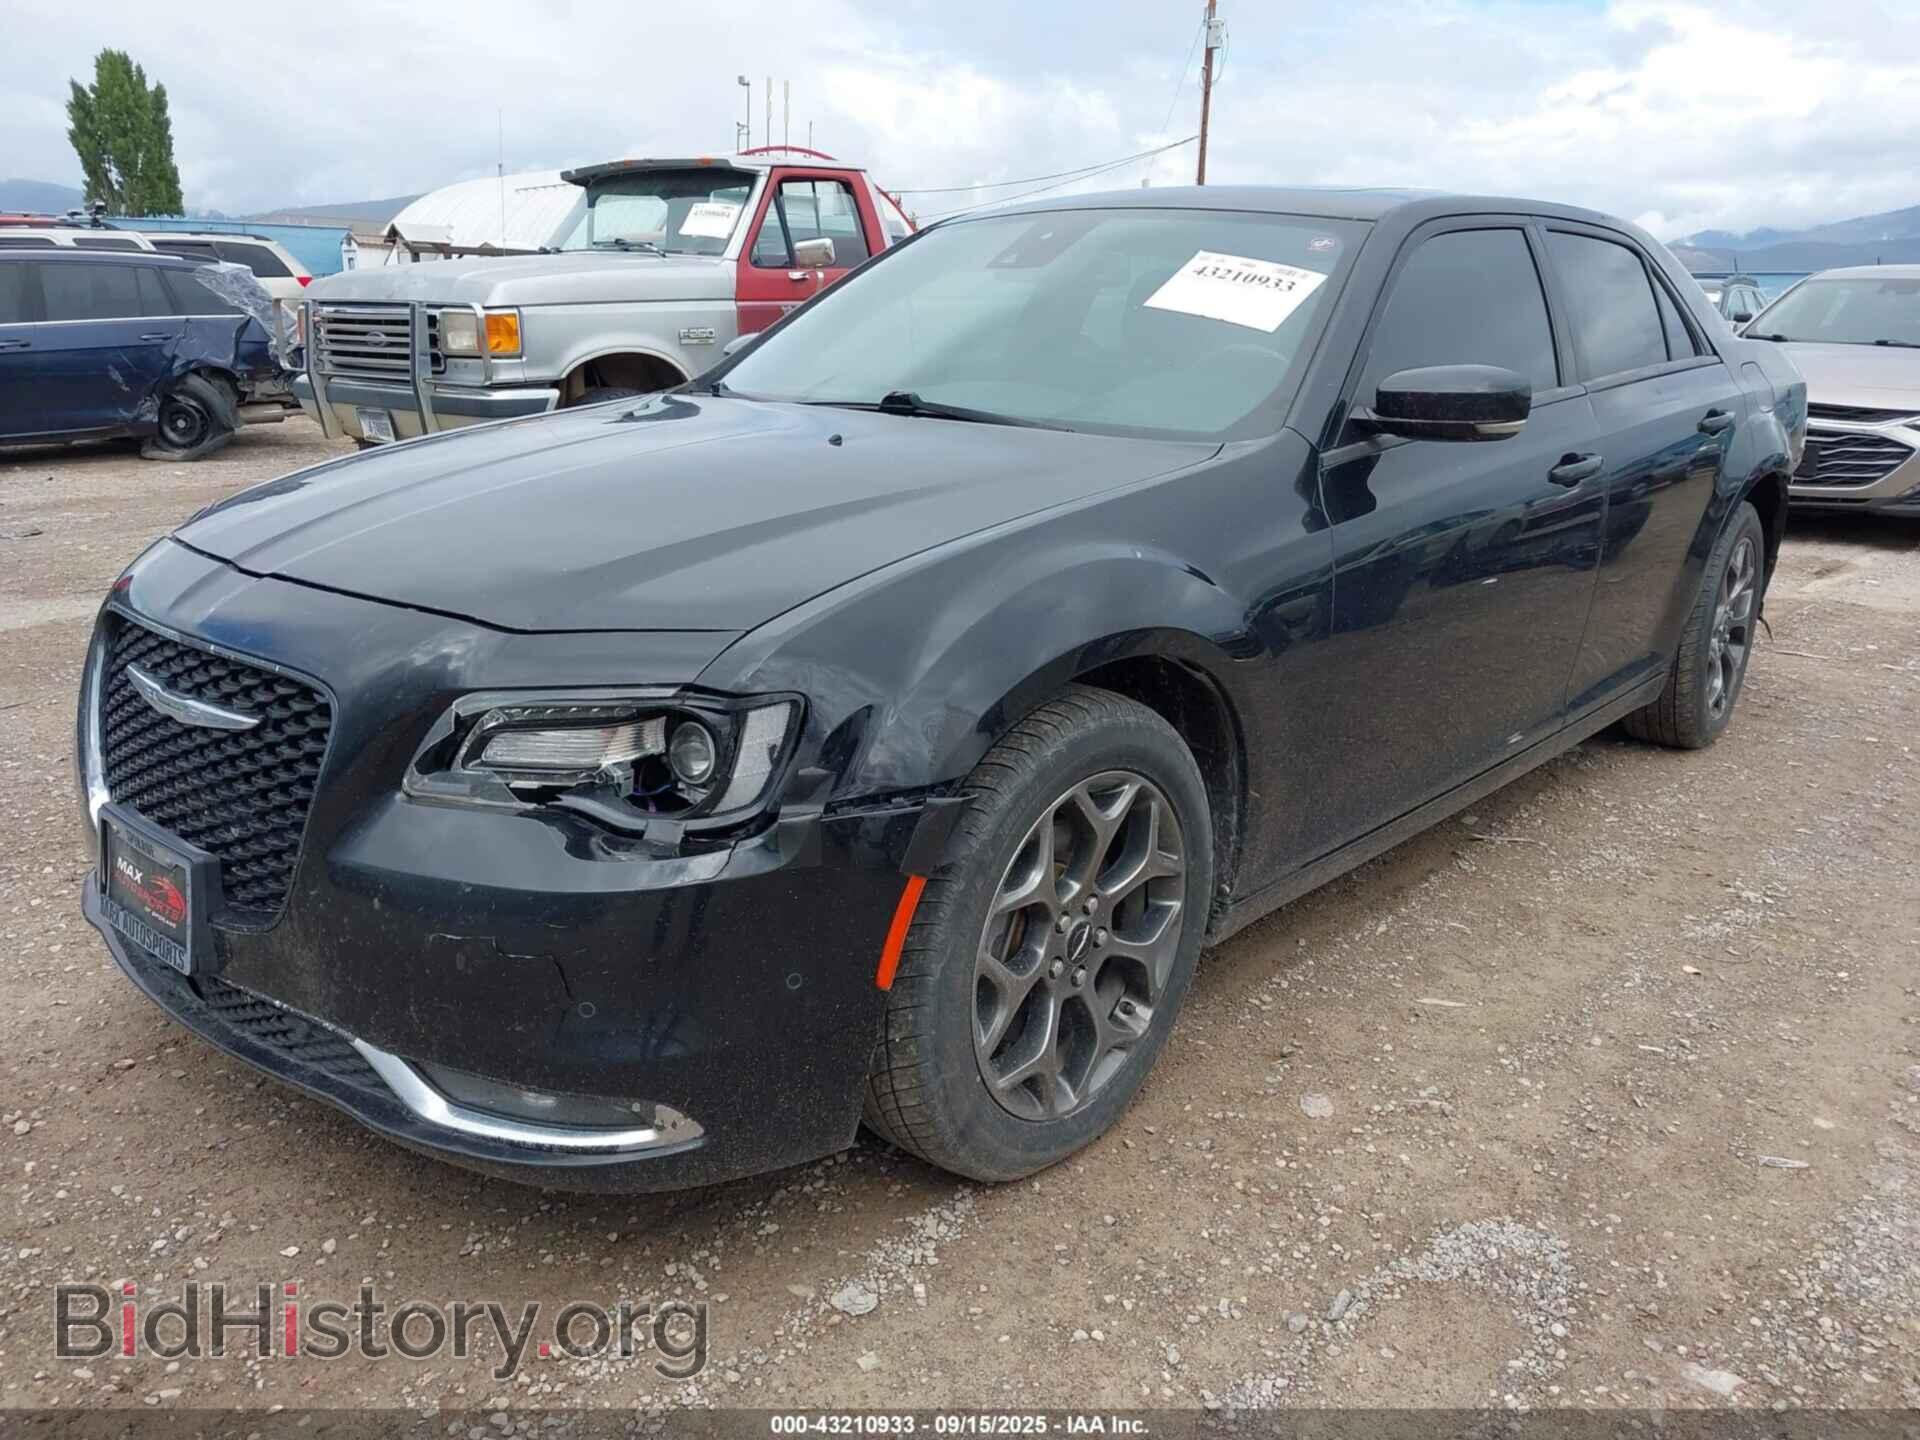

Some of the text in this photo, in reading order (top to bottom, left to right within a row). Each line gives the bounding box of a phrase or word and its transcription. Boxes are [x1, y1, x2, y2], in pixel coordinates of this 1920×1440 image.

[1192, 265, 1296, 292] 43210933
[117, 856, 143, 884] MAX
[119, 911, 185, 971] AUTOSPORTS
